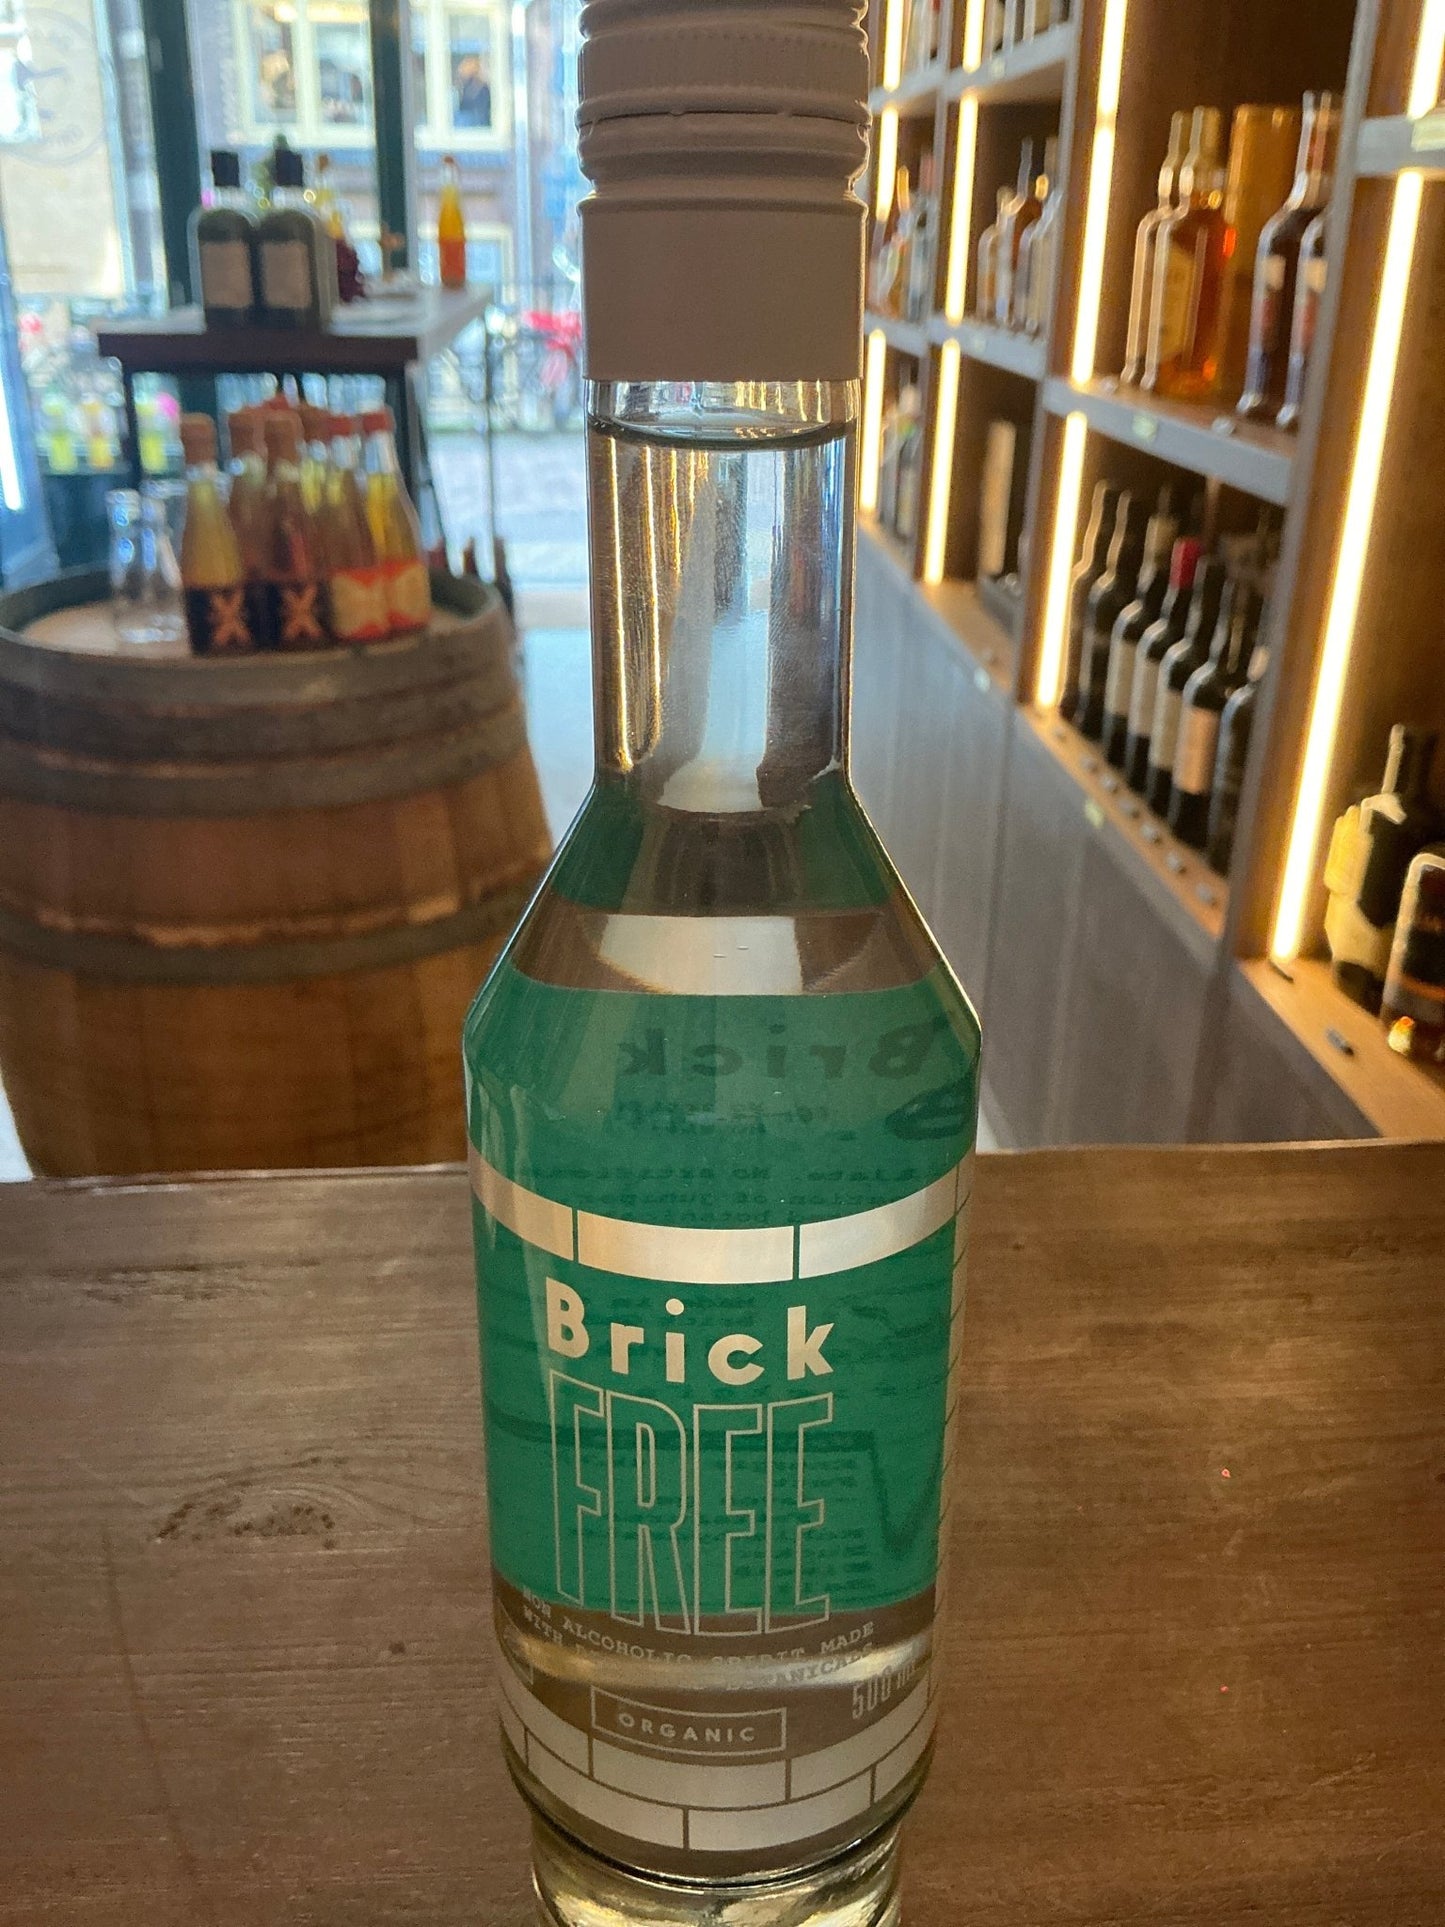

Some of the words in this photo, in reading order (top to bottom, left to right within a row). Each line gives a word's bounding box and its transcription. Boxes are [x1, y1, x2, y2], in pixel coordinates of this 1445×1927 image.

[546, 1276, 835, 1386] Brick
[549, 1368, 834, 1635] FREE
[820, 1621, 874, 1654] MADE
[852, 1665, 893, 1720] 500
[618, 1712, 756, 1743] ORGANIC
